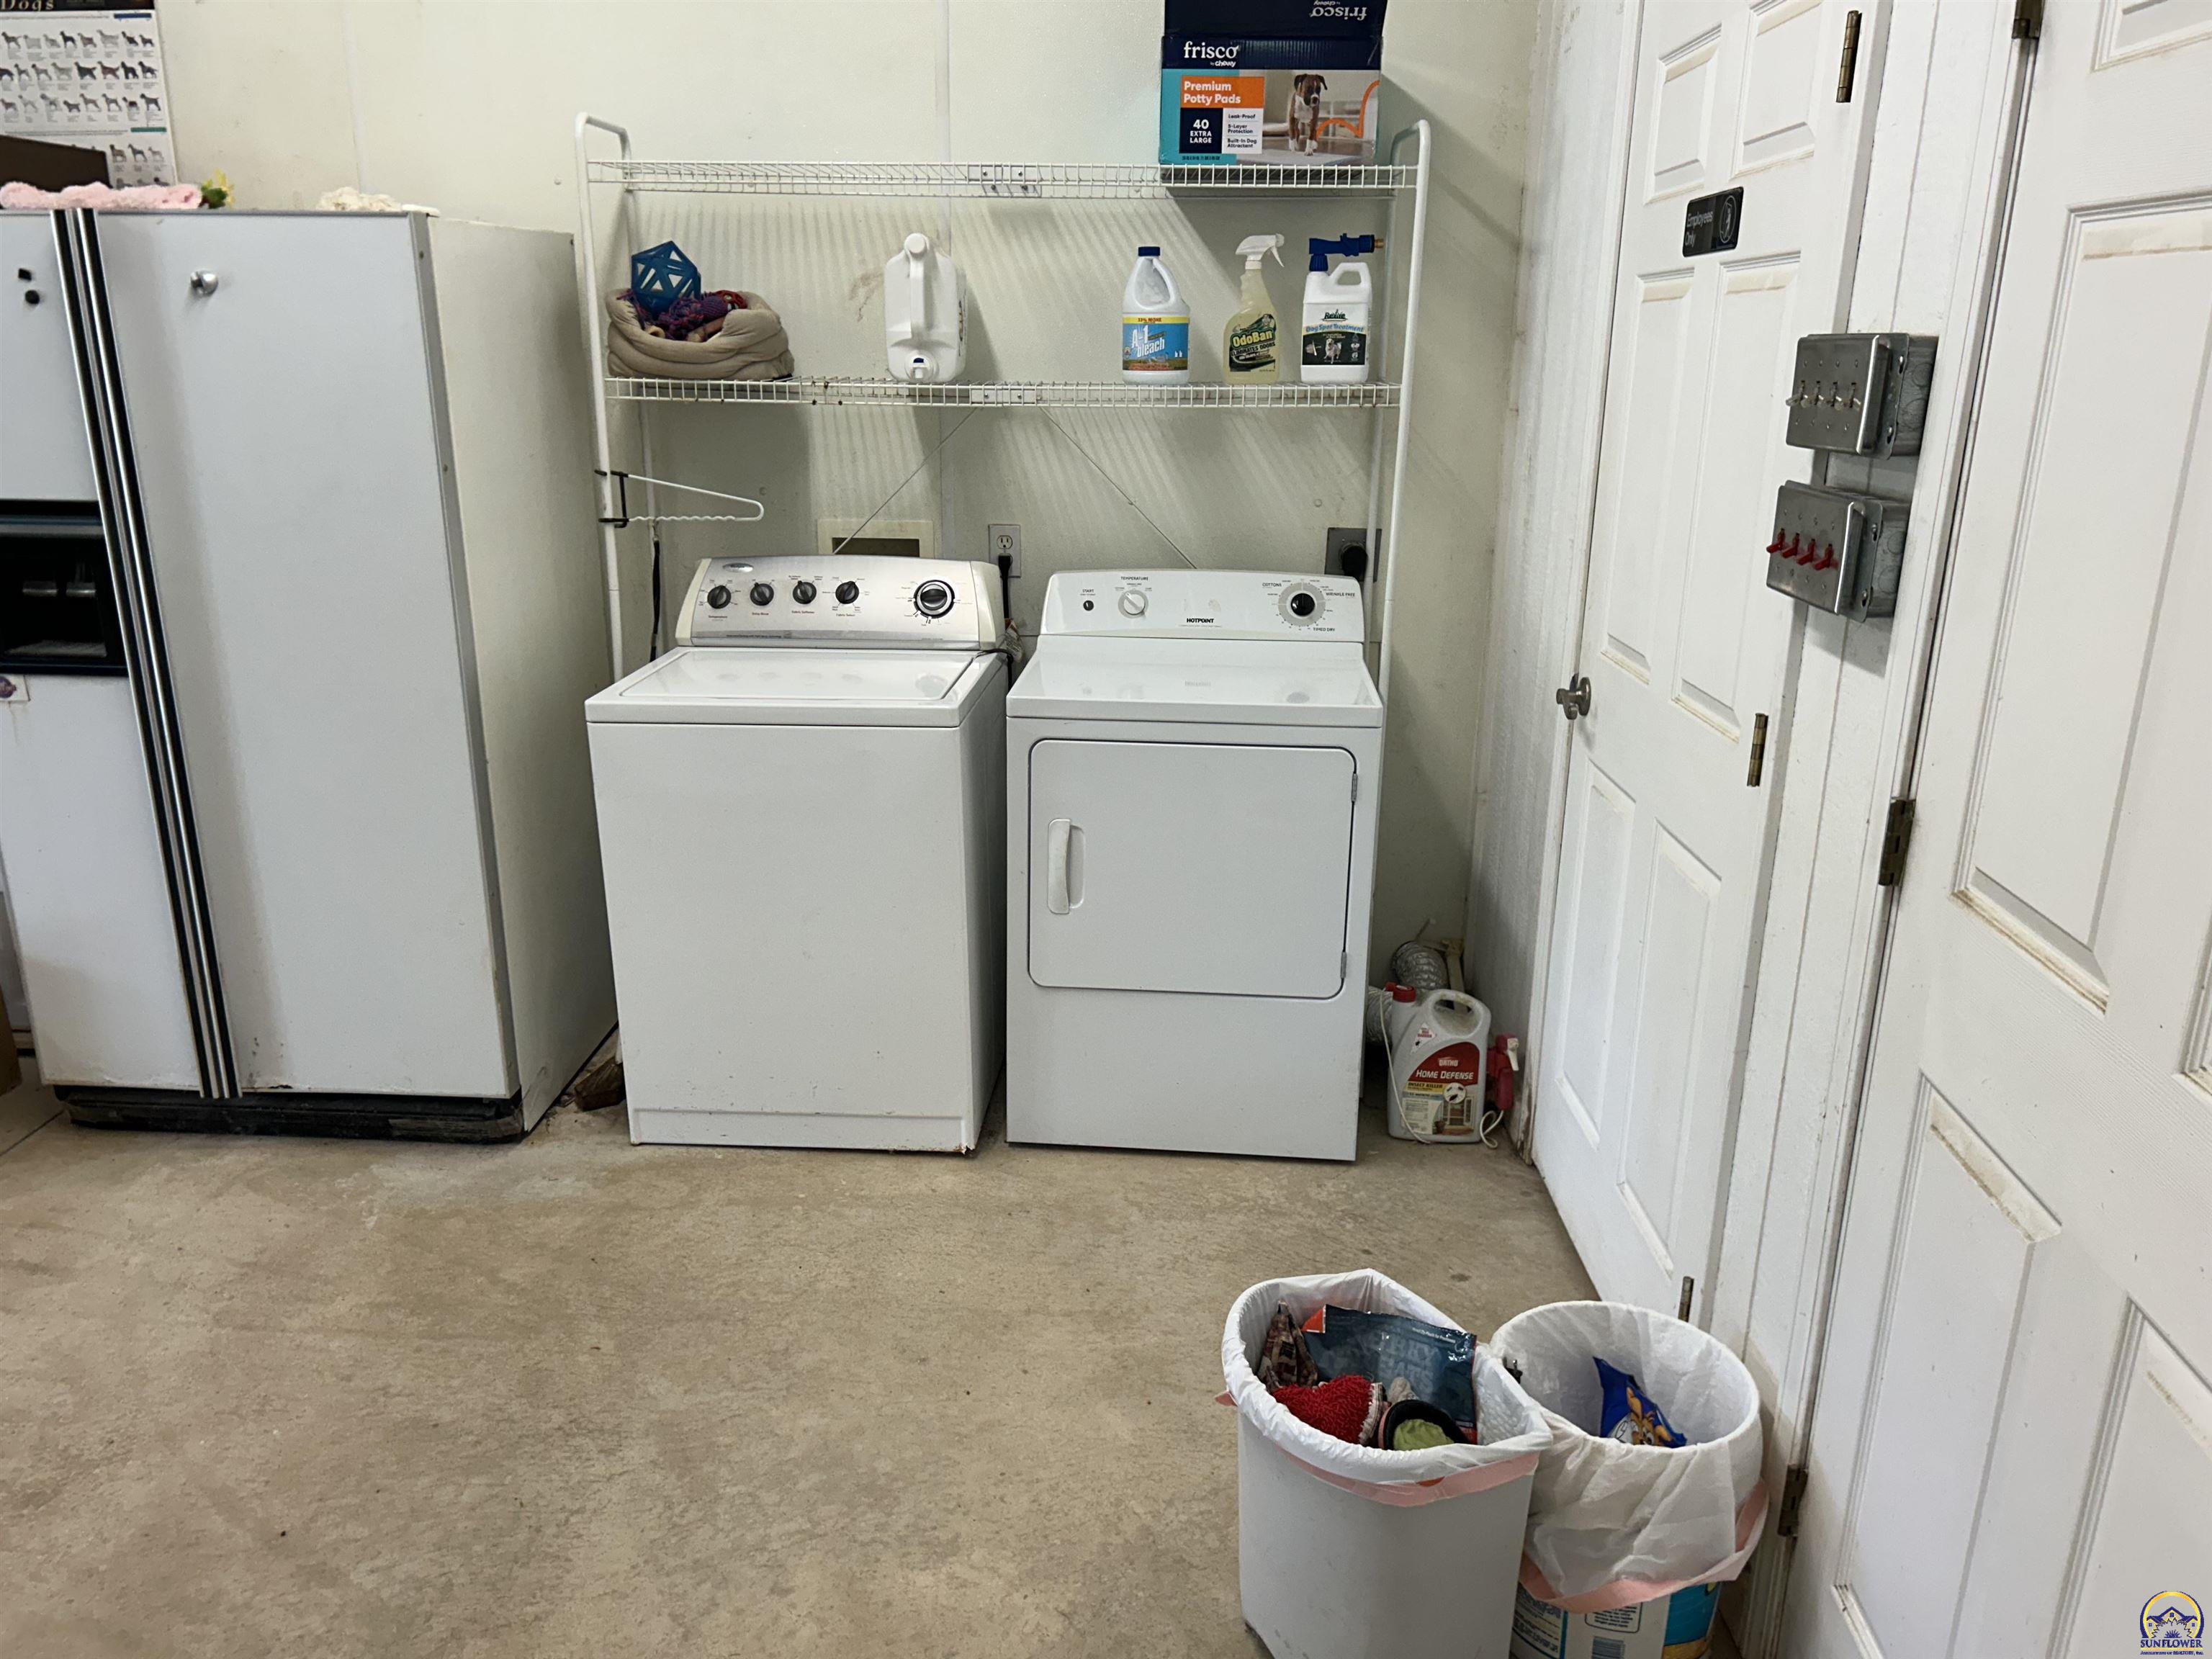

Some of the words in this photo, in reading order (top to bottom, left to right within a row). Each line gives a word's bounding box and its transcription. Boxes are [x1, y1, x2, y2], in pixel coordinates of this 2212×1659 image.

[1, 0, 54, 12] Dogs
[1310, 7, 1367, 21] frisco
[1184, 41, 1239, 58] frisco
[1184, 81, 1232, 91] Premium
[1184, 94, 1213, 106] Potty
[1215, 94, 1241, 104] Pads
[1193, 119, 1210, 129] 40
[1334, 323, 1364, 332] Treatment
[1131, 325, 1148, 349] A-1
[1233, 331, 1273, 347] OdoBan
[1136, 337, 1165, 358] bleach
[1259, 341, 1276, 350] ODORS
[1416, 1069, 1439, 1079] HOME
[1440, 1071, 1474, 1080] DEFENSE
